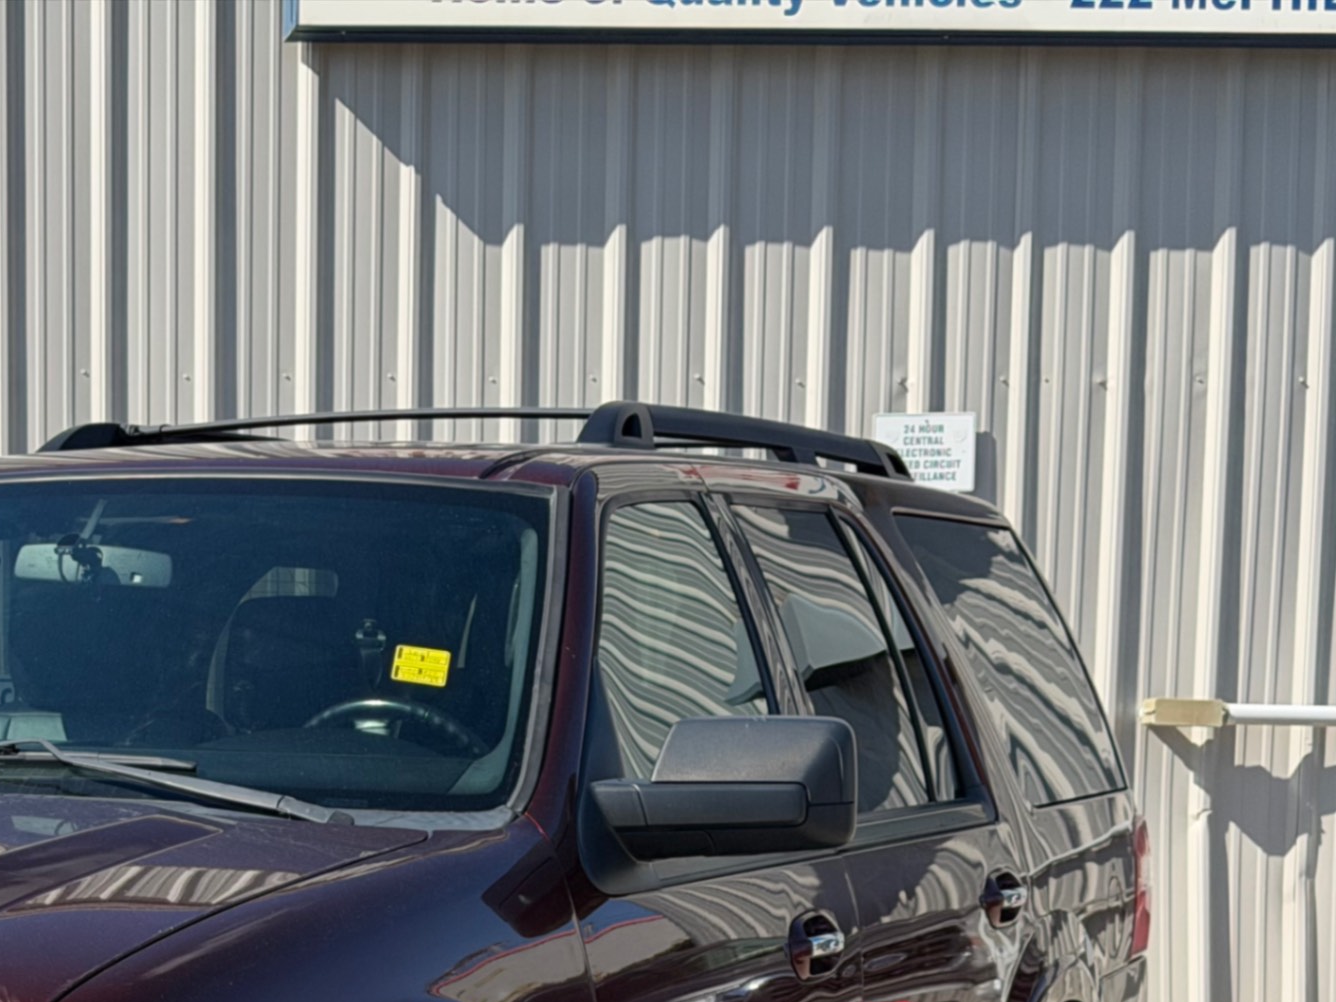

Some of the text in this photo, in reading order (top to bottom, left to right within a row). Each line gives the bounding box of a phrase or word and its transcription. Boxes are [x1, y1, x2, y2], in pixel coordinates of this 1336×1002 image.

[903, 424, 945, 434] 24 HOUR
[903, 436, 944, 446] CENTRAL
[923, 460, 962, 470] CIRCUIT
